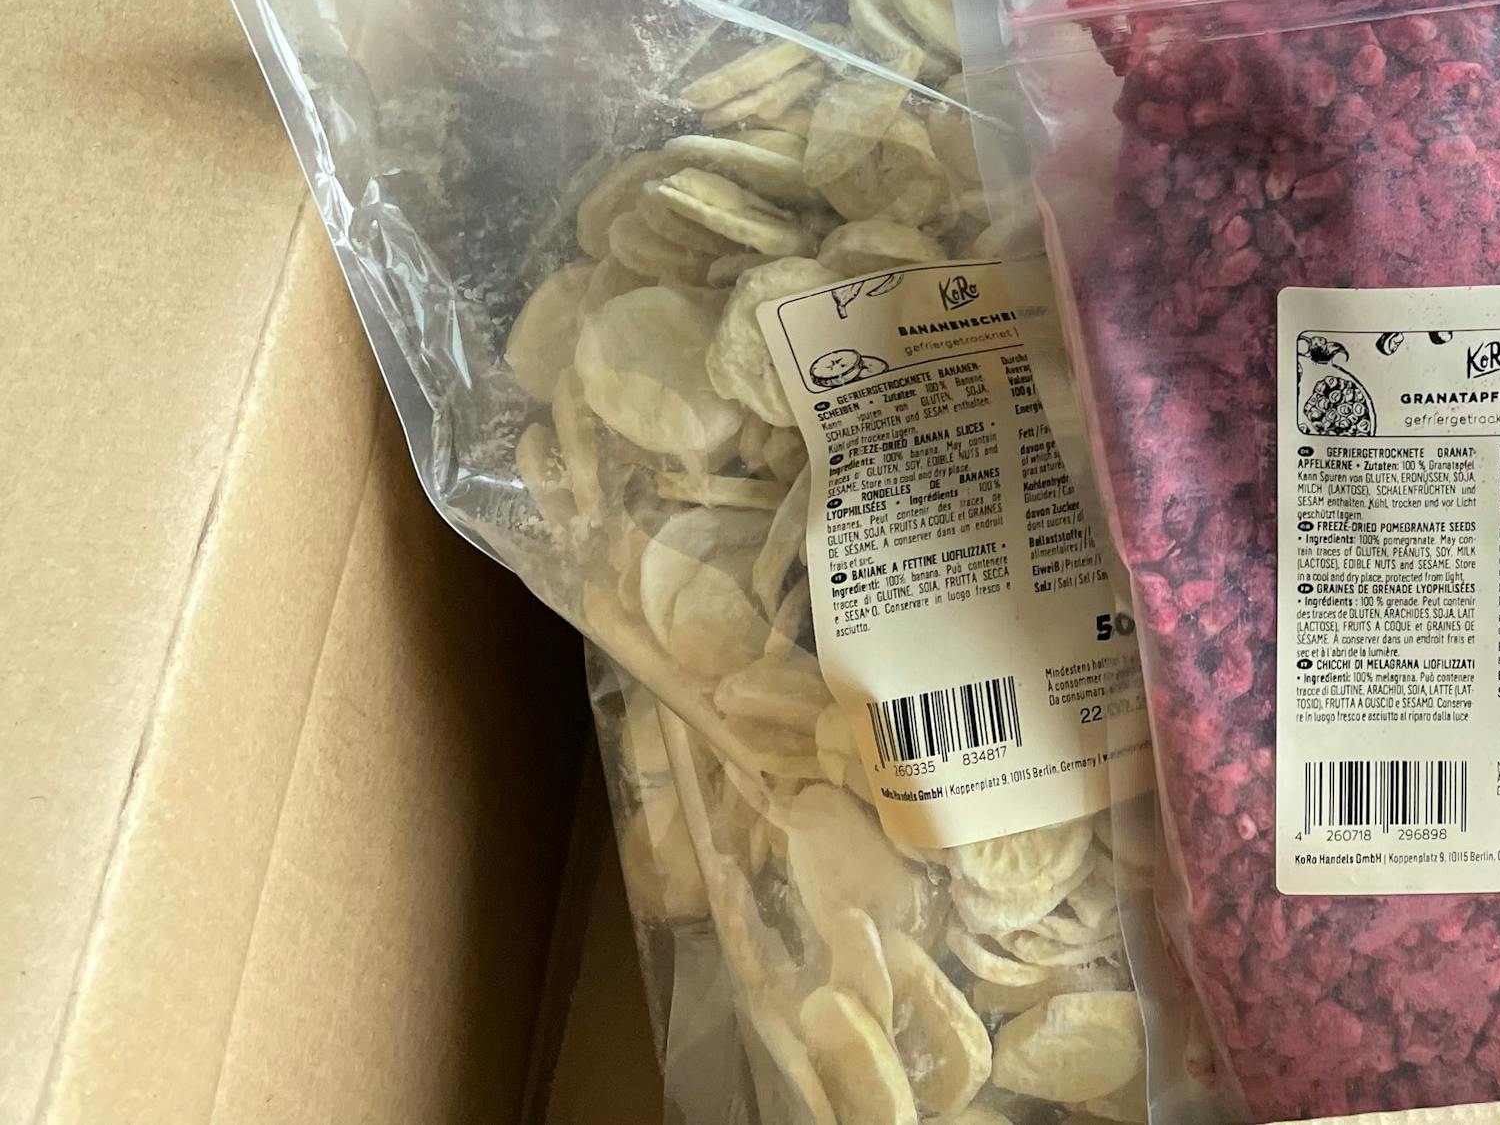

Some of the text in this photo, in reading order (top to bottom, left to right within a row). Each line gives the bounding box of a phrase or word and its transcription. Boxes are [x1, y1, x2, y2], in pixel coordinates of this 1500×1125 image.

[939, 276, 980, 311] KoRo
[899, 307, 1046, 336] BANANENSCHEI
[905, 328, 1013, 356] gefriergetrocknet
[914, 430, 950, 445] BANANA
[956, 422, 984, 437] SLICES
[1327, 447, 1424, 458] GEFRIERGETROCKNETE
[1298, 459, 1352, 469] APFELKERNE
[1364, 461, 1399, 471] Zutaten:
[1402, 460, 1416, 470] 100
[862, 468, 1000, 500] RONDELLES DE BANANES
[827, 490, 958, 521] LYOPHILISÉES Ingrédients
[1317, 522, 1476, 532] FREEZE-DRIED POMEGRANATE SEEDS
[903, 543, 997, 571] FETTINE LIOFILIZZATE
[1317, 583, 1475, 593] GRAINES DE GRENADE LYOPHILISÉES
[1096, 613, 1135, 641] 50
[1317, 660, 1475, 670] CHICCHI DI MELAGRANA LIOFILIZZATI
[963, 746, 1007, 765] 834817
[918, 781, 943, 800] GmbH
[950, 777, 1000, 796] Koppenplatz
[1011, 769, 1031, 785] 10115
[1060, 754, 1096, 773] Germany
[1295, 829, 1447, 841] 4 260718 296898
[1295, 855, 1317, 865] KoRo
[1320, 854, 1354, 864] Handels
[1356, 853, 1381, 863] GmbH
[1389, 853, 1437, 864] Koppenplatz
[1449, 852, 1468, 862] 10115
